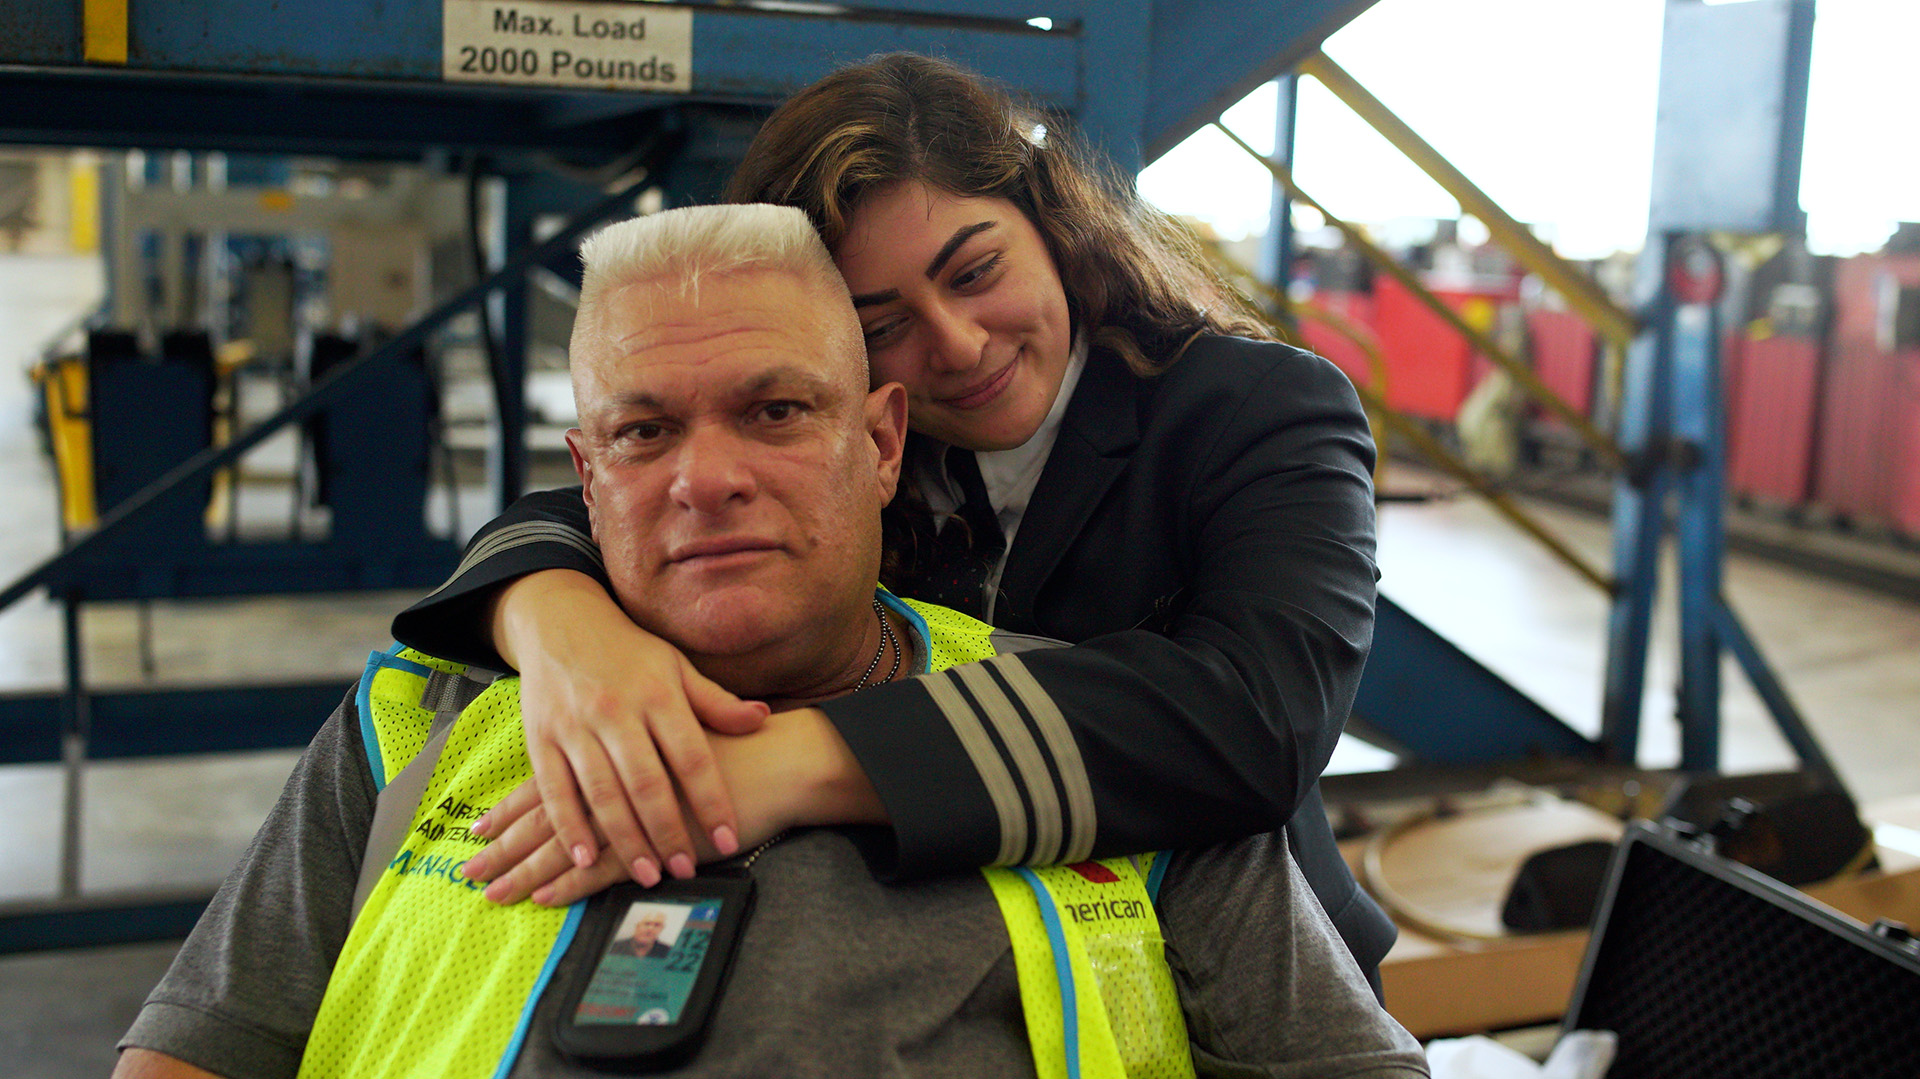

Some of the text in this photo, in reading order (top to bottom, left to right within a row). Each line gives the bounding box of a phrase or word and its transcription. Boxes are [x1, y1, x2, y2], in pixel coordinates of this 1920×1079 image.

[493, 8, 646, 40] Max. Load
[460, 46, 676, 83] 2000 Pounds
[389, 850, 489, 891] MANAG
